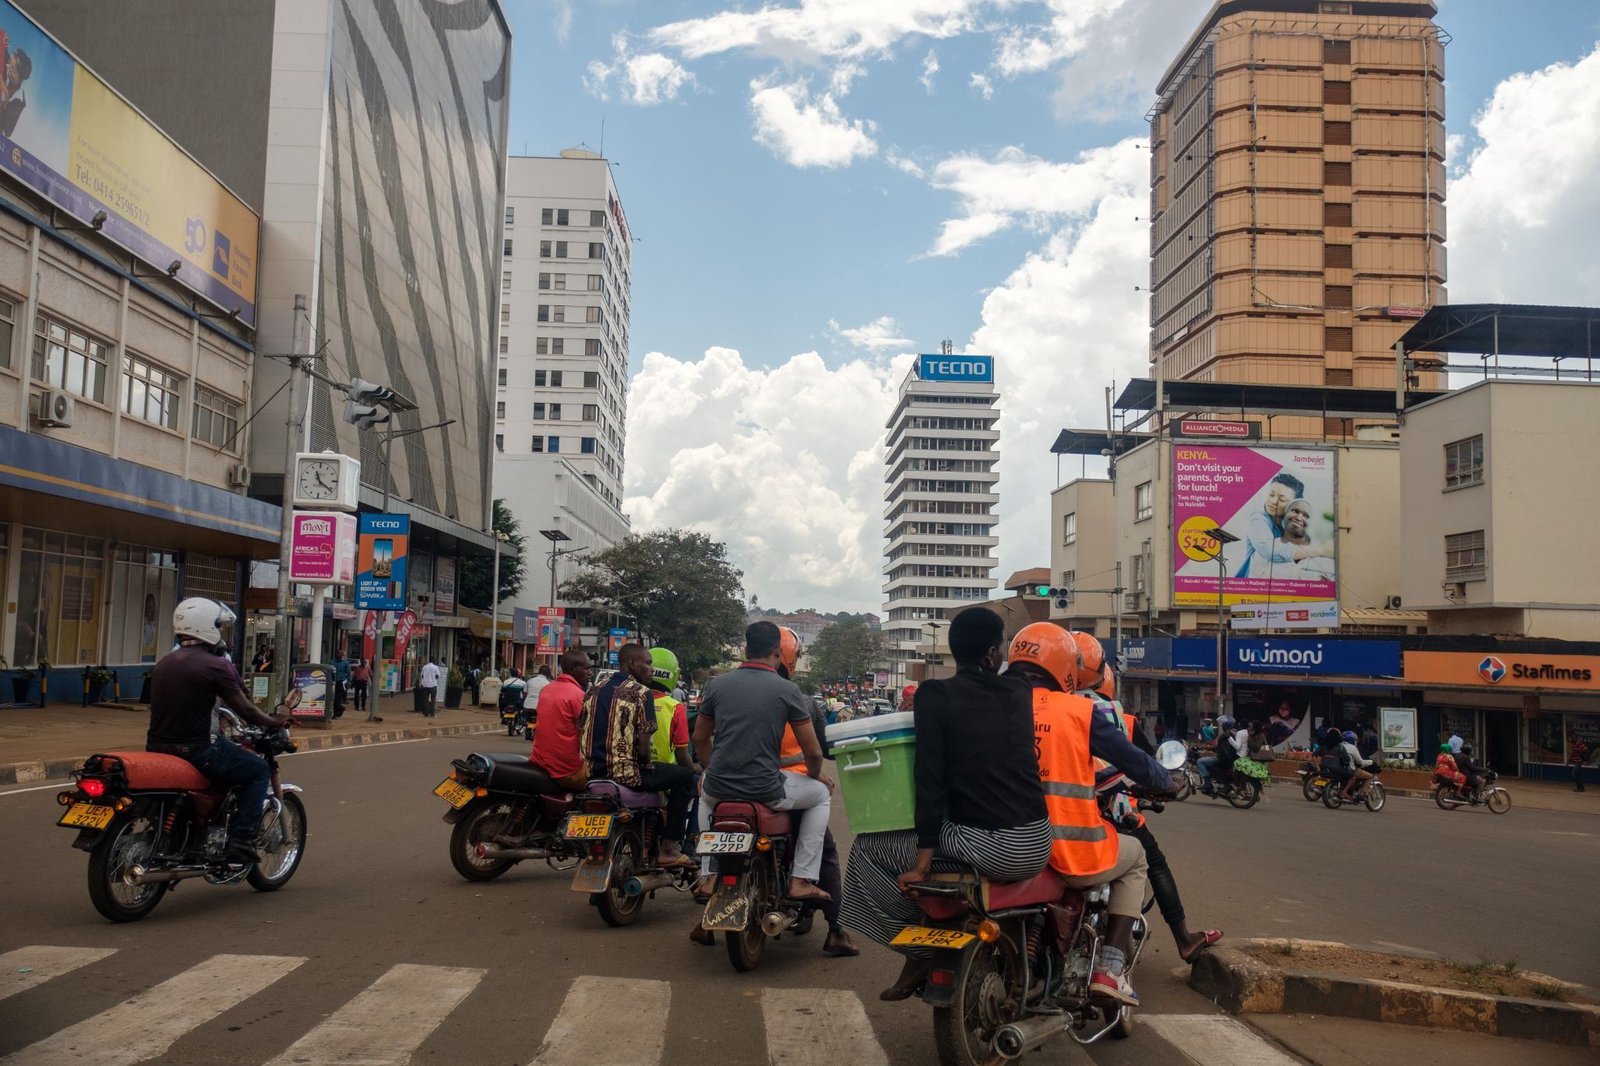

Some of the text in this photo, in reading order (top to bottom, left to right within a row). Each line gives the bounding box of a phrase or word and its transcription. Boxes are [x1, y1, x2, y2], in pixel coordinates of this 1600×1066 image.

[76, 164, 91, 187] Tel:
[94, 178, 114, 202] 0414
[926, 361, 986, 375] TECNO
[1177, 450, 1216, 460] KENYA...
[1294, 456, 1325, 465] Jambojet
[1222, 466, 1241, 475] your
[1178, 474, 1212, 482] parents,
[1214, 474, 1234, 484] drop
[1192, 483, 1218, 492] lunch!
[1183, 535, 1216, 550] $120
[397, 615, 414, 644] Sale
[1015, 641, 1040, 656] 5972
[1239, 642, 1322, 664] unimoni
[1512, 664, 1592, 681] StarTimes
[585, 816, 606, 826] UEG
[577, 827, 604, 836] 267F
[711, 843, 744, 852] 227P
[928, 929, 964, 938] UED
